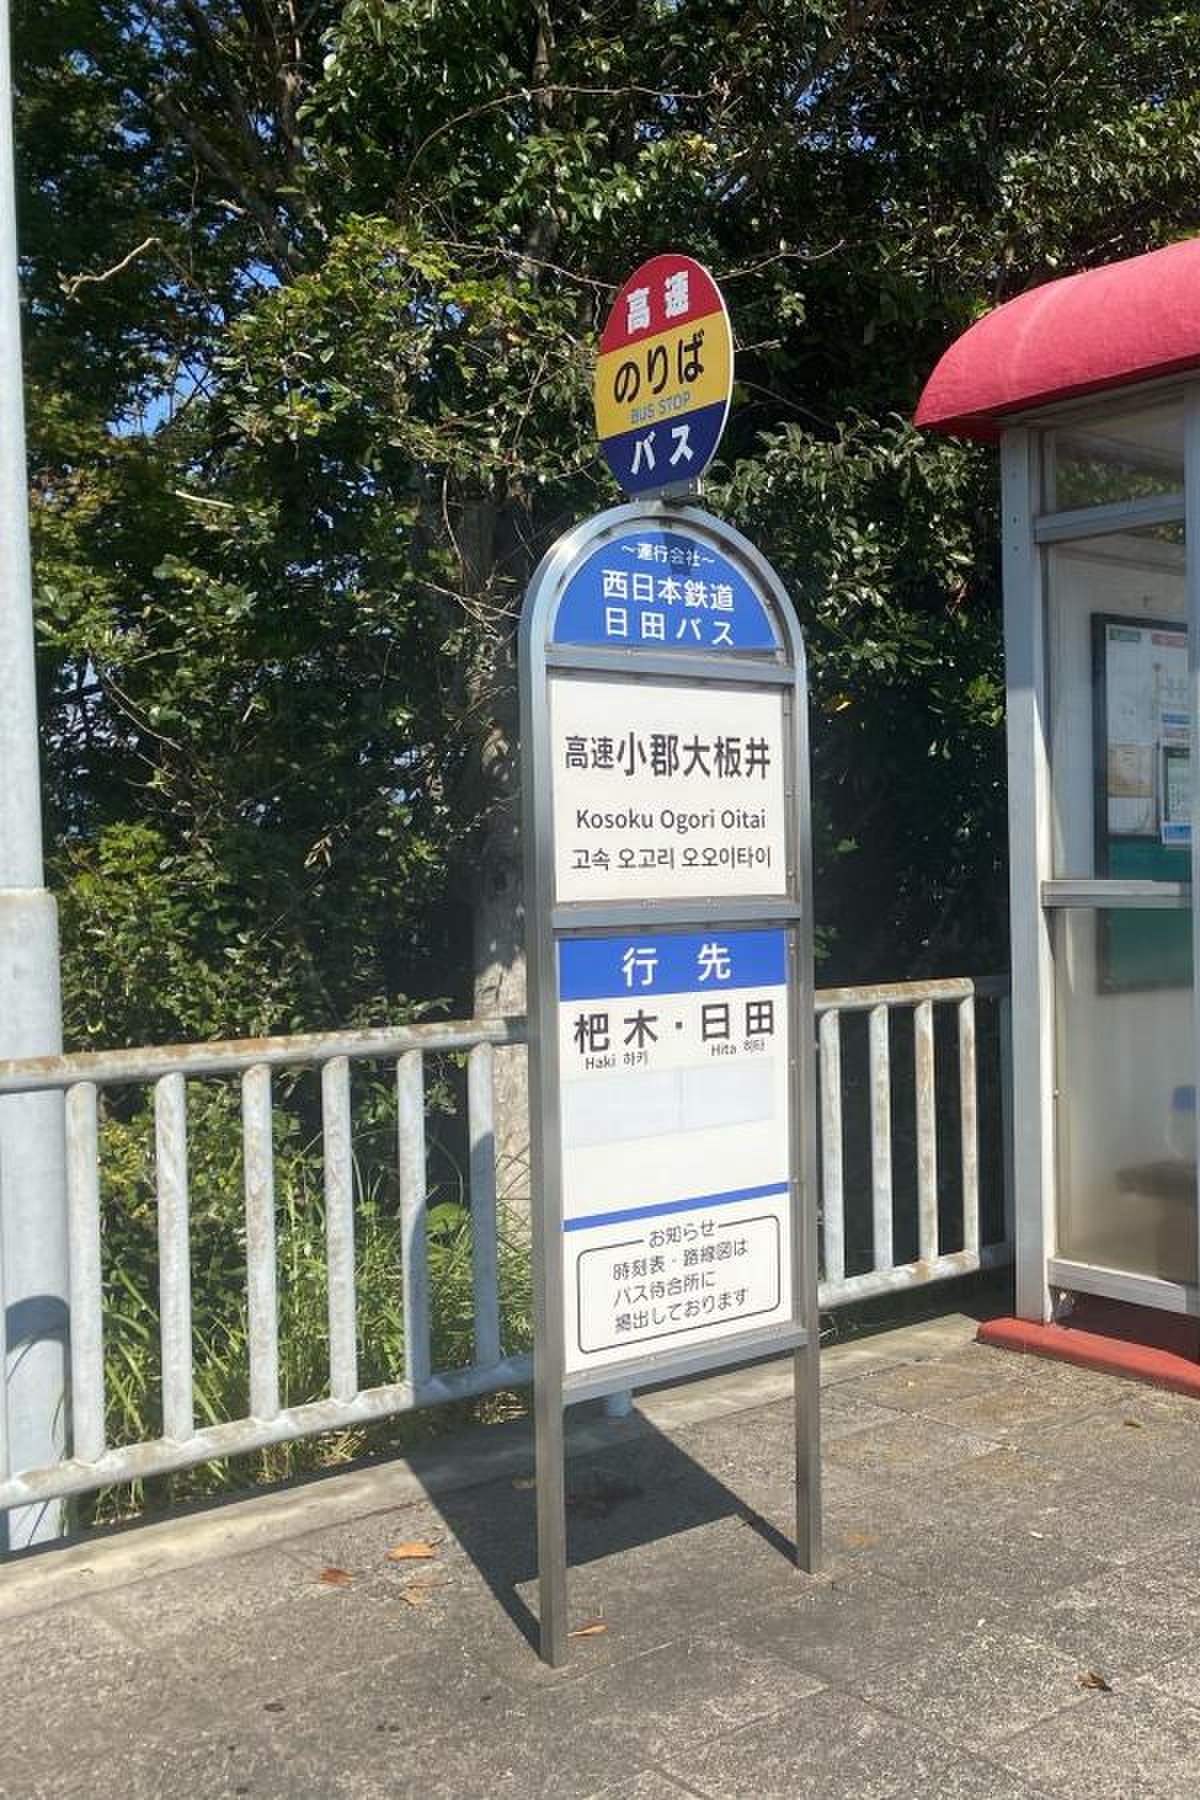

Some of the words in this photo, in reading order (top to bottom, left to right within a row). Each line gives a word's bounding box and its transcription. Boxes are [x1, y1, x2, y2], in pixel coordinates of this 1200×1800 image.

[626, 271, 688, 334] 高速
[614, 329, 705, 403] のりば
[631, 407, 655, 424] BUS
[658, 391, 690, 415] STOP
[631, 424, 694, 475] バス
[602, 569, 735, 611] 西日本鉄道
[605, 608, 734, 645] 日田バス
[565, 732, 771, 779] 高速小郡大板井
[577, 808, 653, 829] Kosoku
[660, 809, 715, 834] Ogori
[721, 808, 766, 829] Oitai
[571, 848, 611, 870] 고속
[617, 847, 675, 870] 오고리
[682, 846, 771, 869] 오오이타이
[622, 942, 731, 987] 行先
[585, 1053, 616, 1070] Haki
[711, 1044, 737, 1057] Hita
[649, 1219, 715, 1248] お知らせ
[612, 1238, 749, 1281] 時刻表・路線図は
[613, 1271, 715, 1307] バス待合所に
[614, 1288, 748, 1333] 掲出しております
